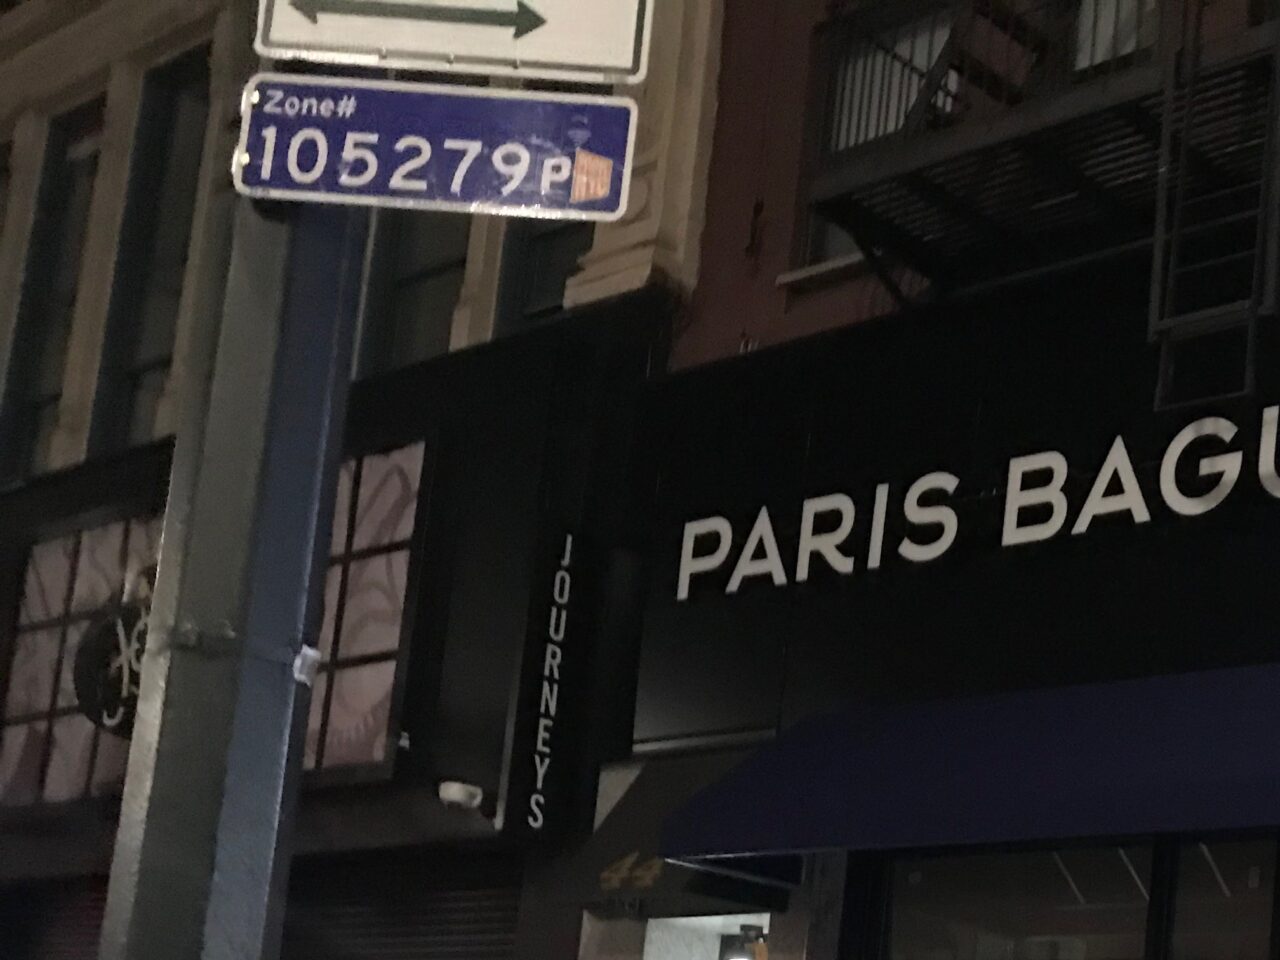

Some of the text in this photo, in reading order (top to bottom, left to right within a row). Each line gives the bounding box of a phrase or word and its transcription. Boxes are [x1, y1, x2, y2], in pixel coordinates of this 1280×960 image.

[263, 90, 357, 118] Zone#
[259, 125, 531, 197] 105279
[677, 471, 960, 600] PARIS
[528, 534, 572, 828] JOURNEYS
